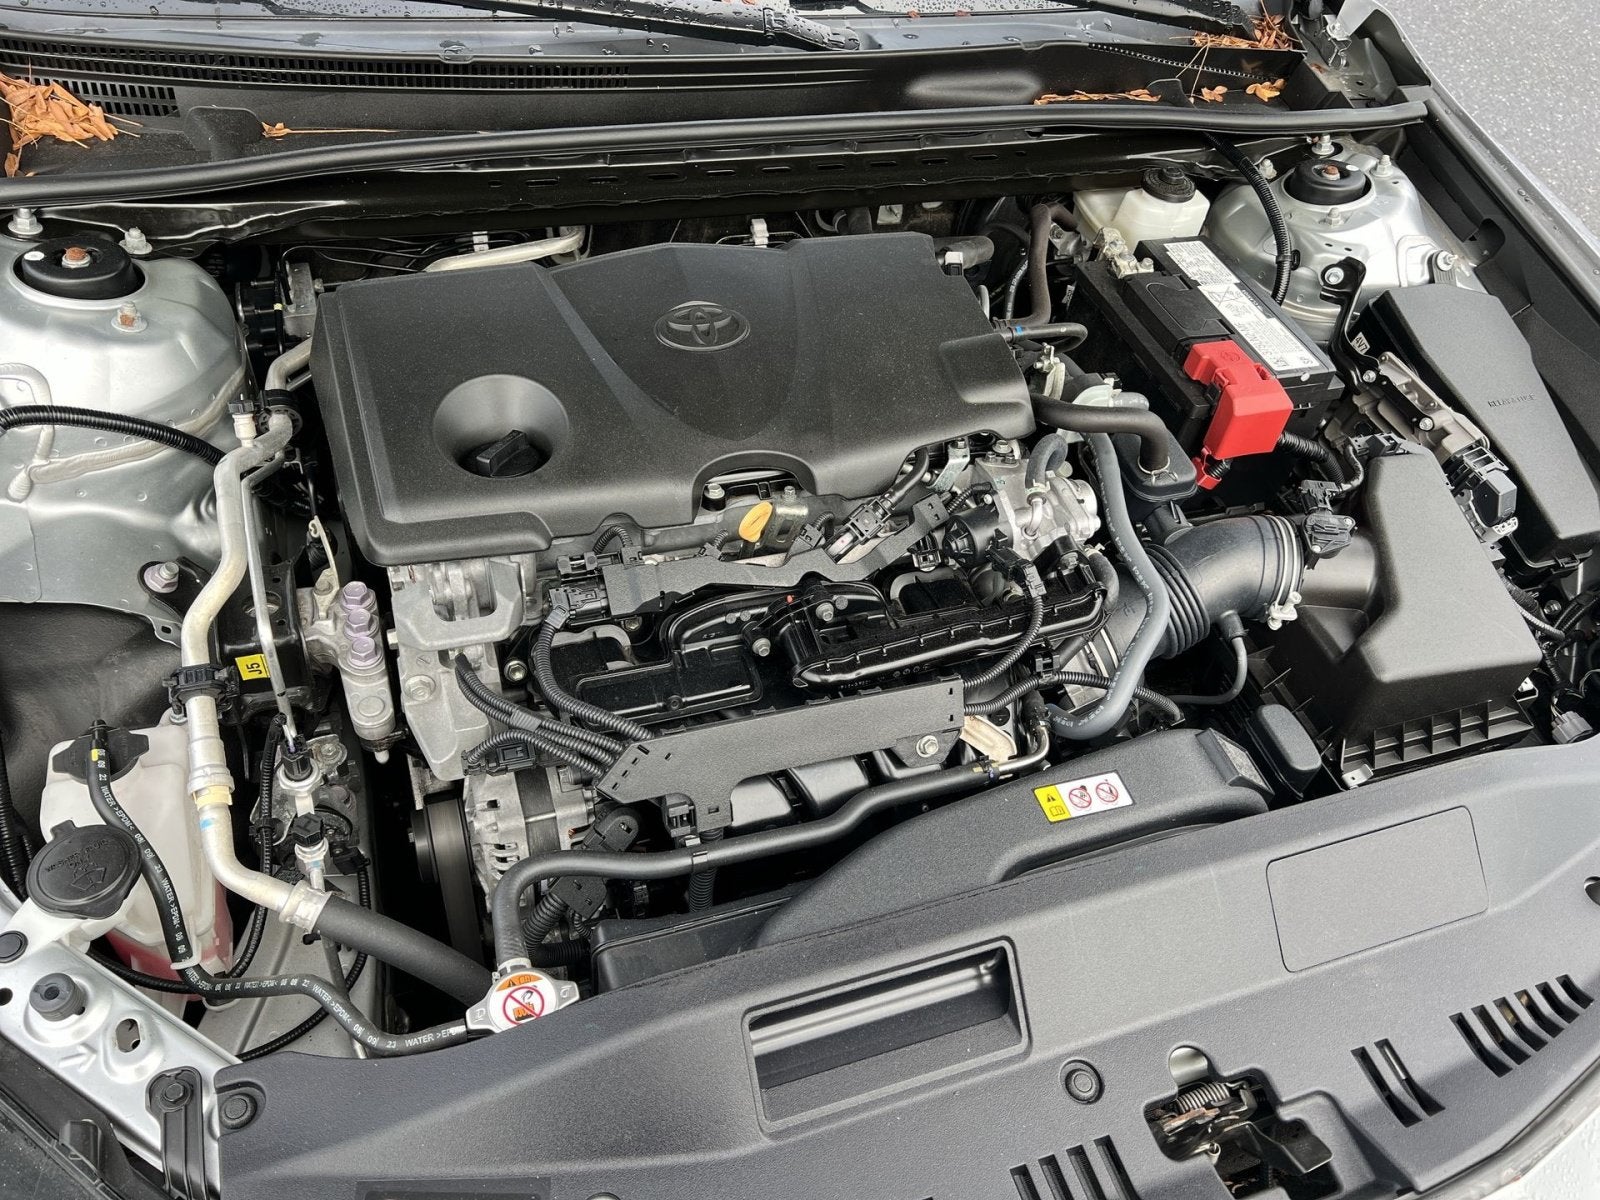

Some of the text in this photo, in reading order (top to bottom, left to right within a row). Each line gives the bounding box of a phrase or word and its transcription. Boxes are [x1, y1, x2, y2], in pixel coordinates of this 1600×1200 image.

[245, 662, 263, 675] J5
[101, 785, 116, 808] WATER
[161, 877, 175, 904] WATER
[312, 983, 332, 1005] WATER
[329, 999, 353, 1024] >EPDM<
[404, 1033, 435, 1048] WATER
